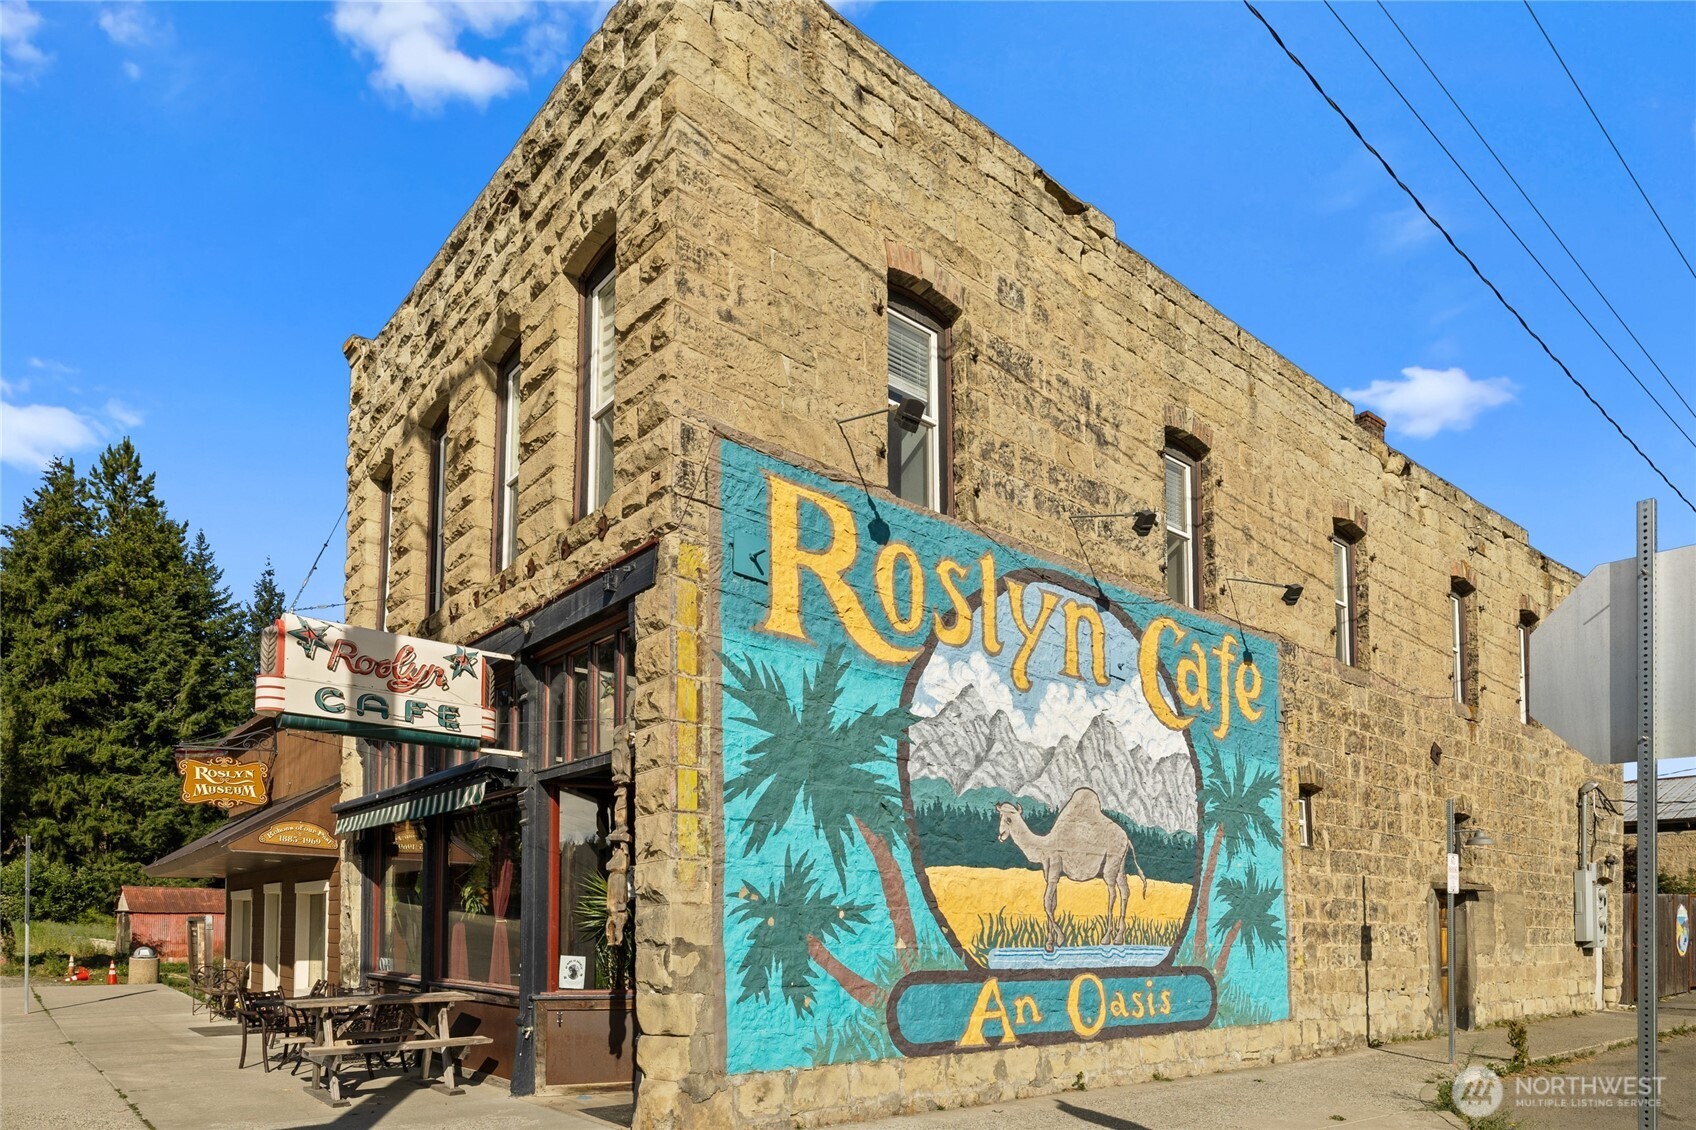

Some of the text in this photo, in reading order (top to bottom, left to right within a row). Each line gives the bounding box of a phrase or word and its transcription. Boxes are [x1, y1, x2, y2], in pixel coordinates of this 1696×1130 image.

[764, 474, 1264, 740] Roslyn Cafe
[327, 639, 447, 693] Roslyn
[315, 687, 461, 732] CAFE
[193, 766, 254, 784] ROSLYN
[193, 784, 258, 798] MUSEUM
[957, 973, 1172, 1048] An Oasis
